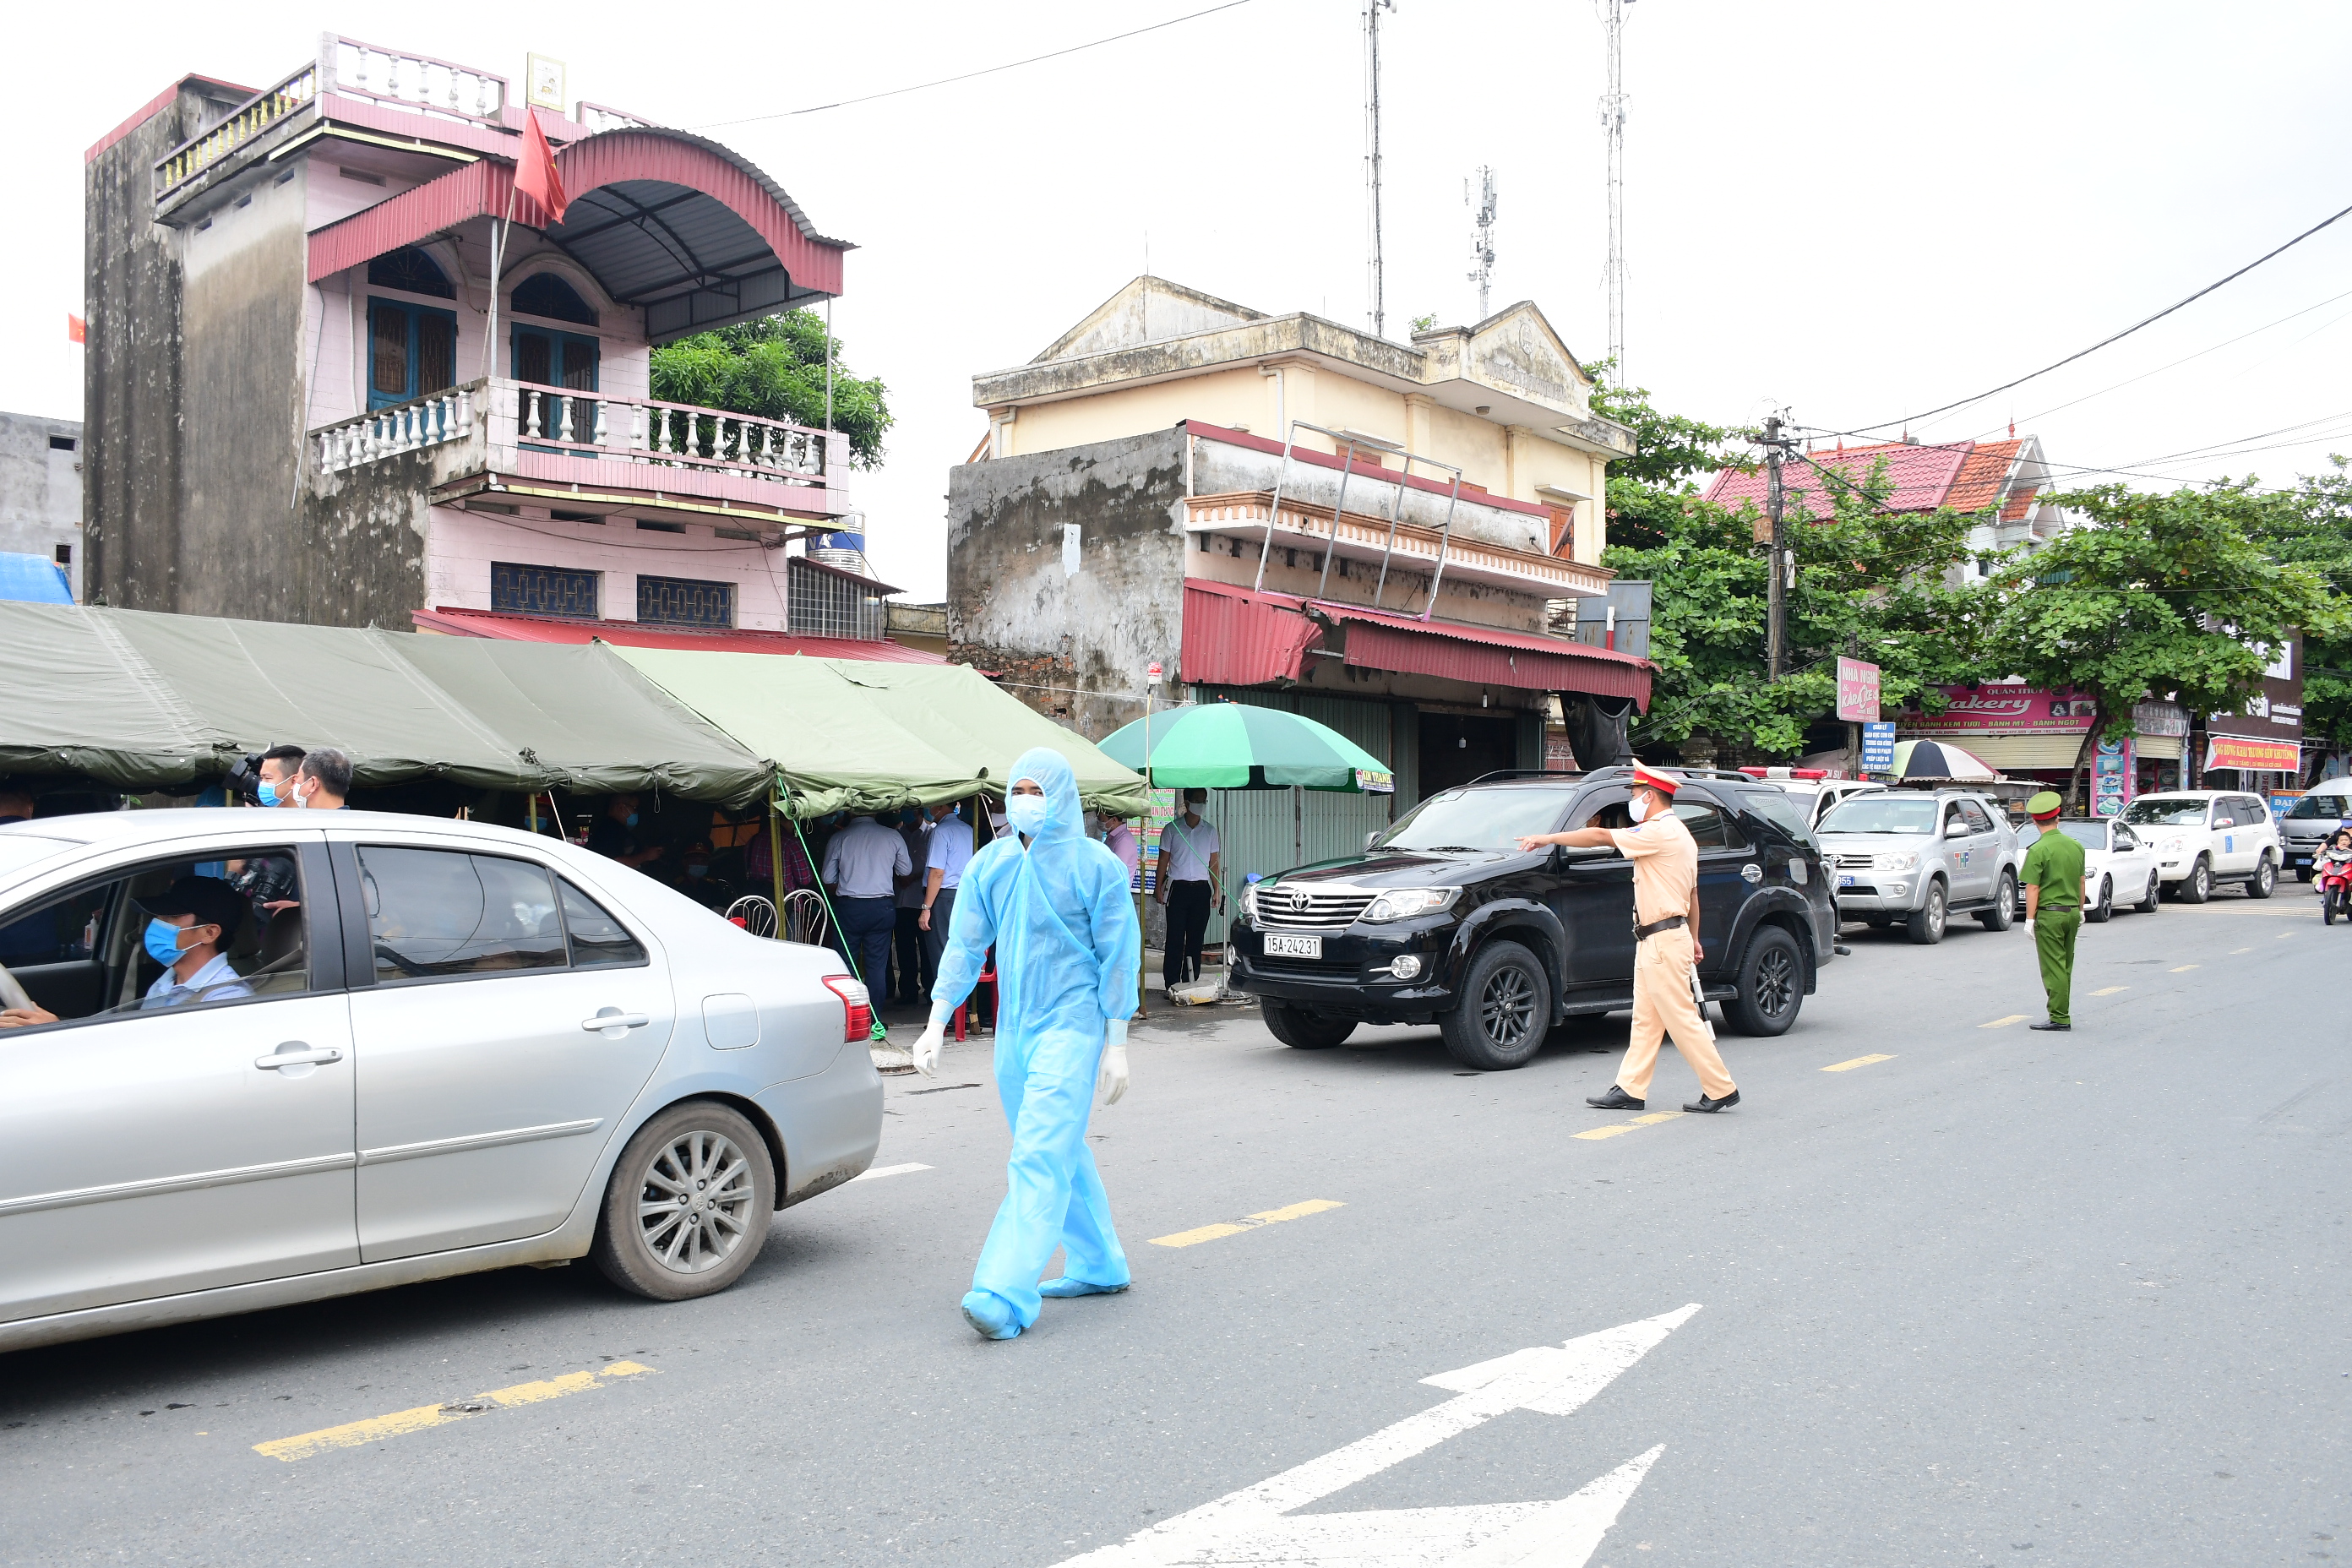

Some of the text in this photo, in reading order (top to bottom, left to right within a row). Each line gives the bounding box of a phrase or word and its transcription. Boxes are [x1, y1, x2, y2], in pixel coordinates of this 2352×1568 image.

[1843, 683, 1849, 692] &
[2273, 798, 2292, 808] ĐẠI
[1954, 851, 1970, 870] THP
